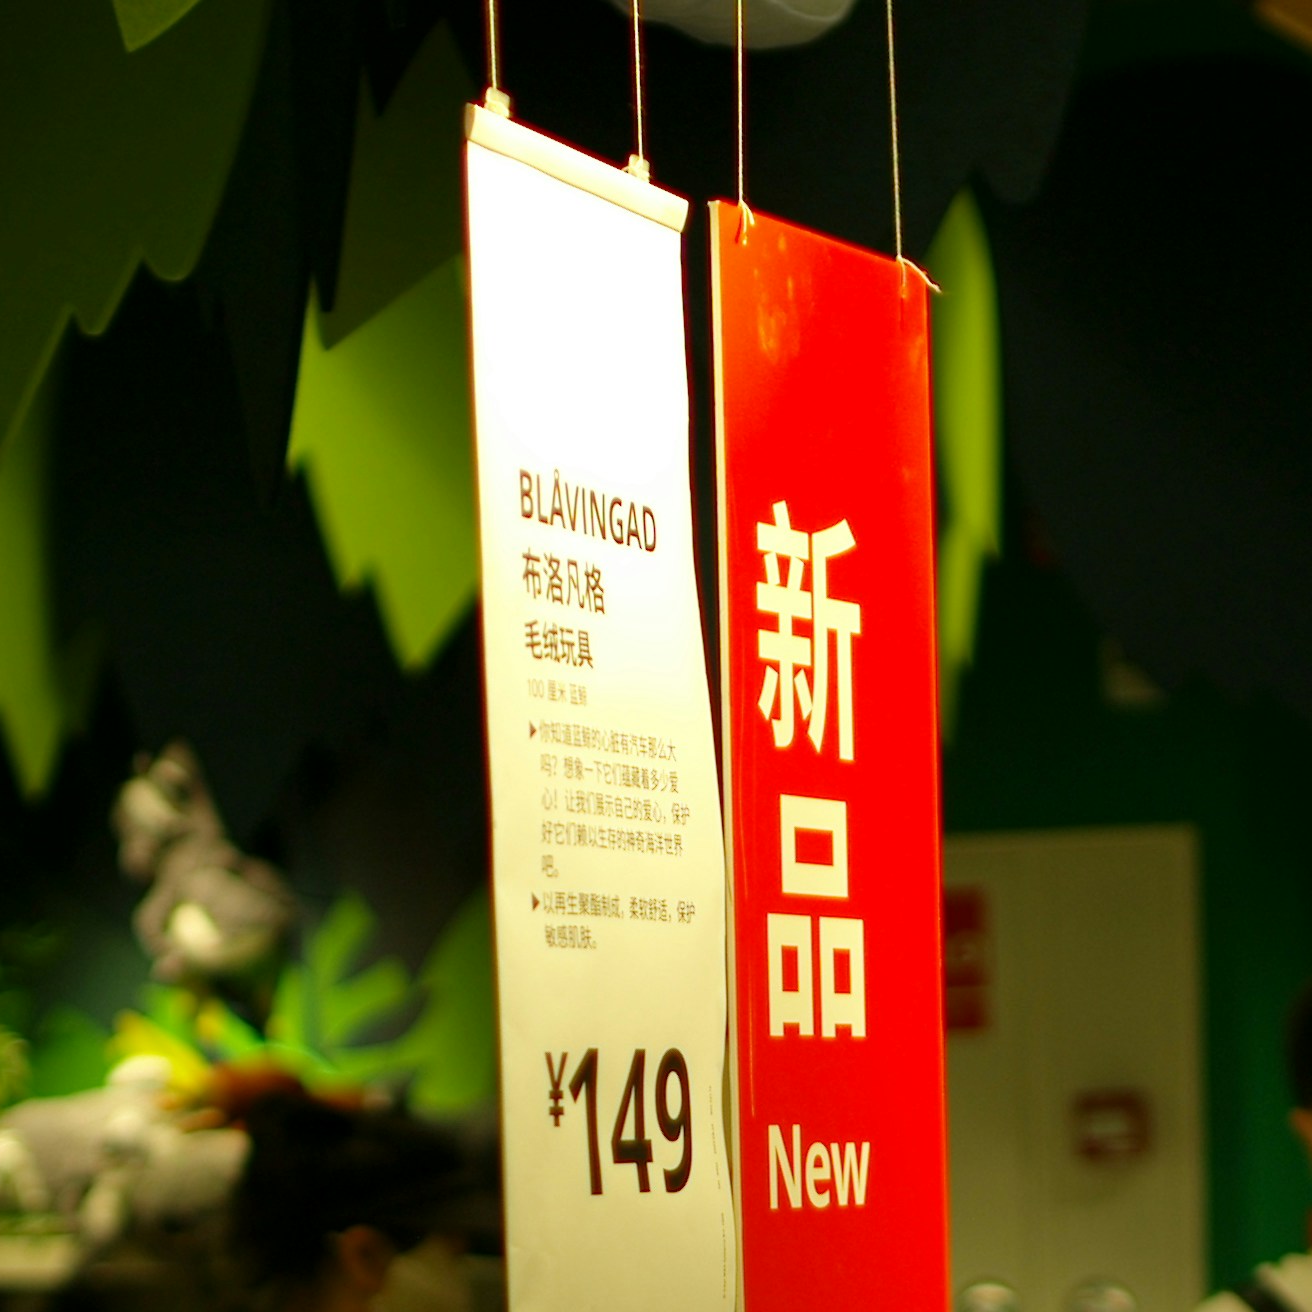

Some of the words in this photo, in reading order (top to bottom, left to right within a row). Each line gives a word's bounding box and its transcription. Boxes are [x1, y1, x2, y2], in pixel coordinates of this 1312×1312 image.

[519, 468, 657, 552] BLÅVINGAD
[522, 548, 606, 615] 布洛凡格
[525, 620, 594, 669] 毛绒玩具
[527, 678, 544, 698] 100
[756, 500, 868, 1039] 新品
[767, 1123, 871, 1210] New
